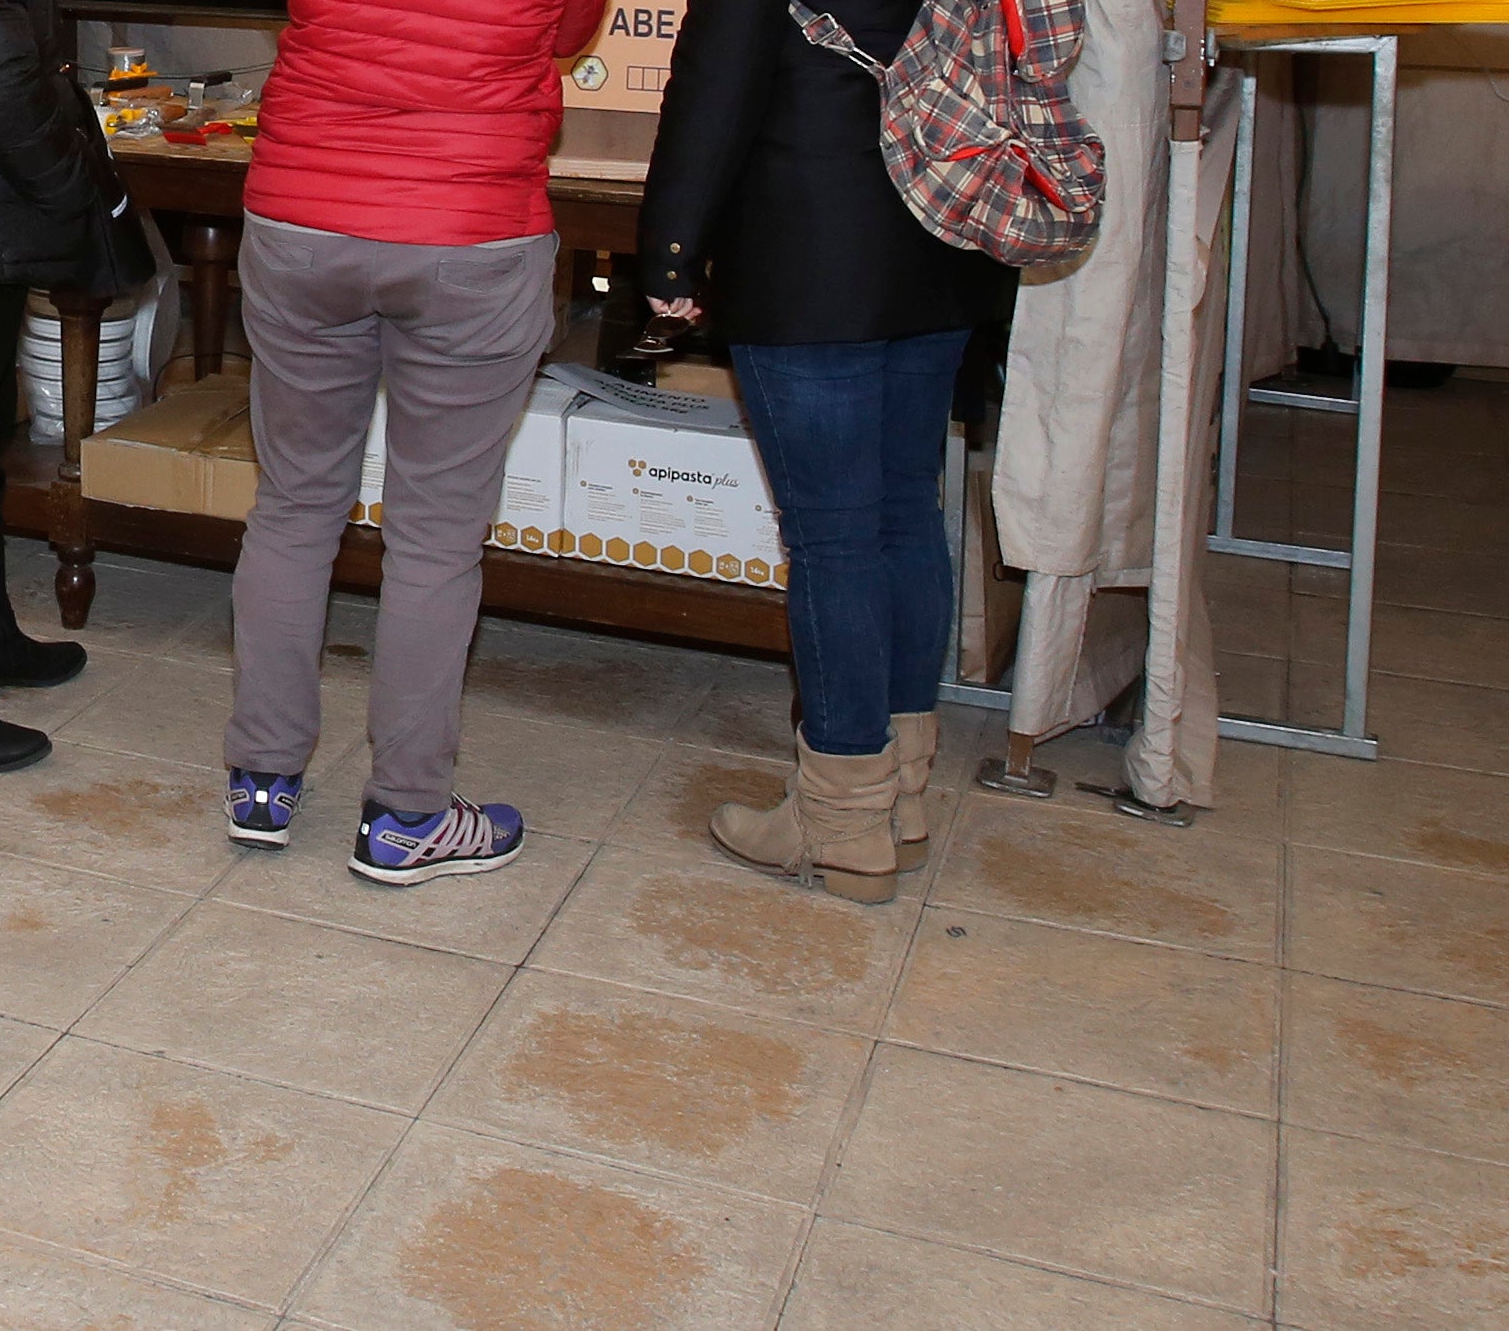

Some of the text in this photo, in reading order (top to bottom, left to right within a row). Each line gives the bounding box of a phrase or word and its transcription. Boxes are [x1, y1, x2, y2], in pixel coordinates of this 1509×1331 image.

[608, 7, 676, 39] ABE
[648, 467, 740, 490] apipasta plus
